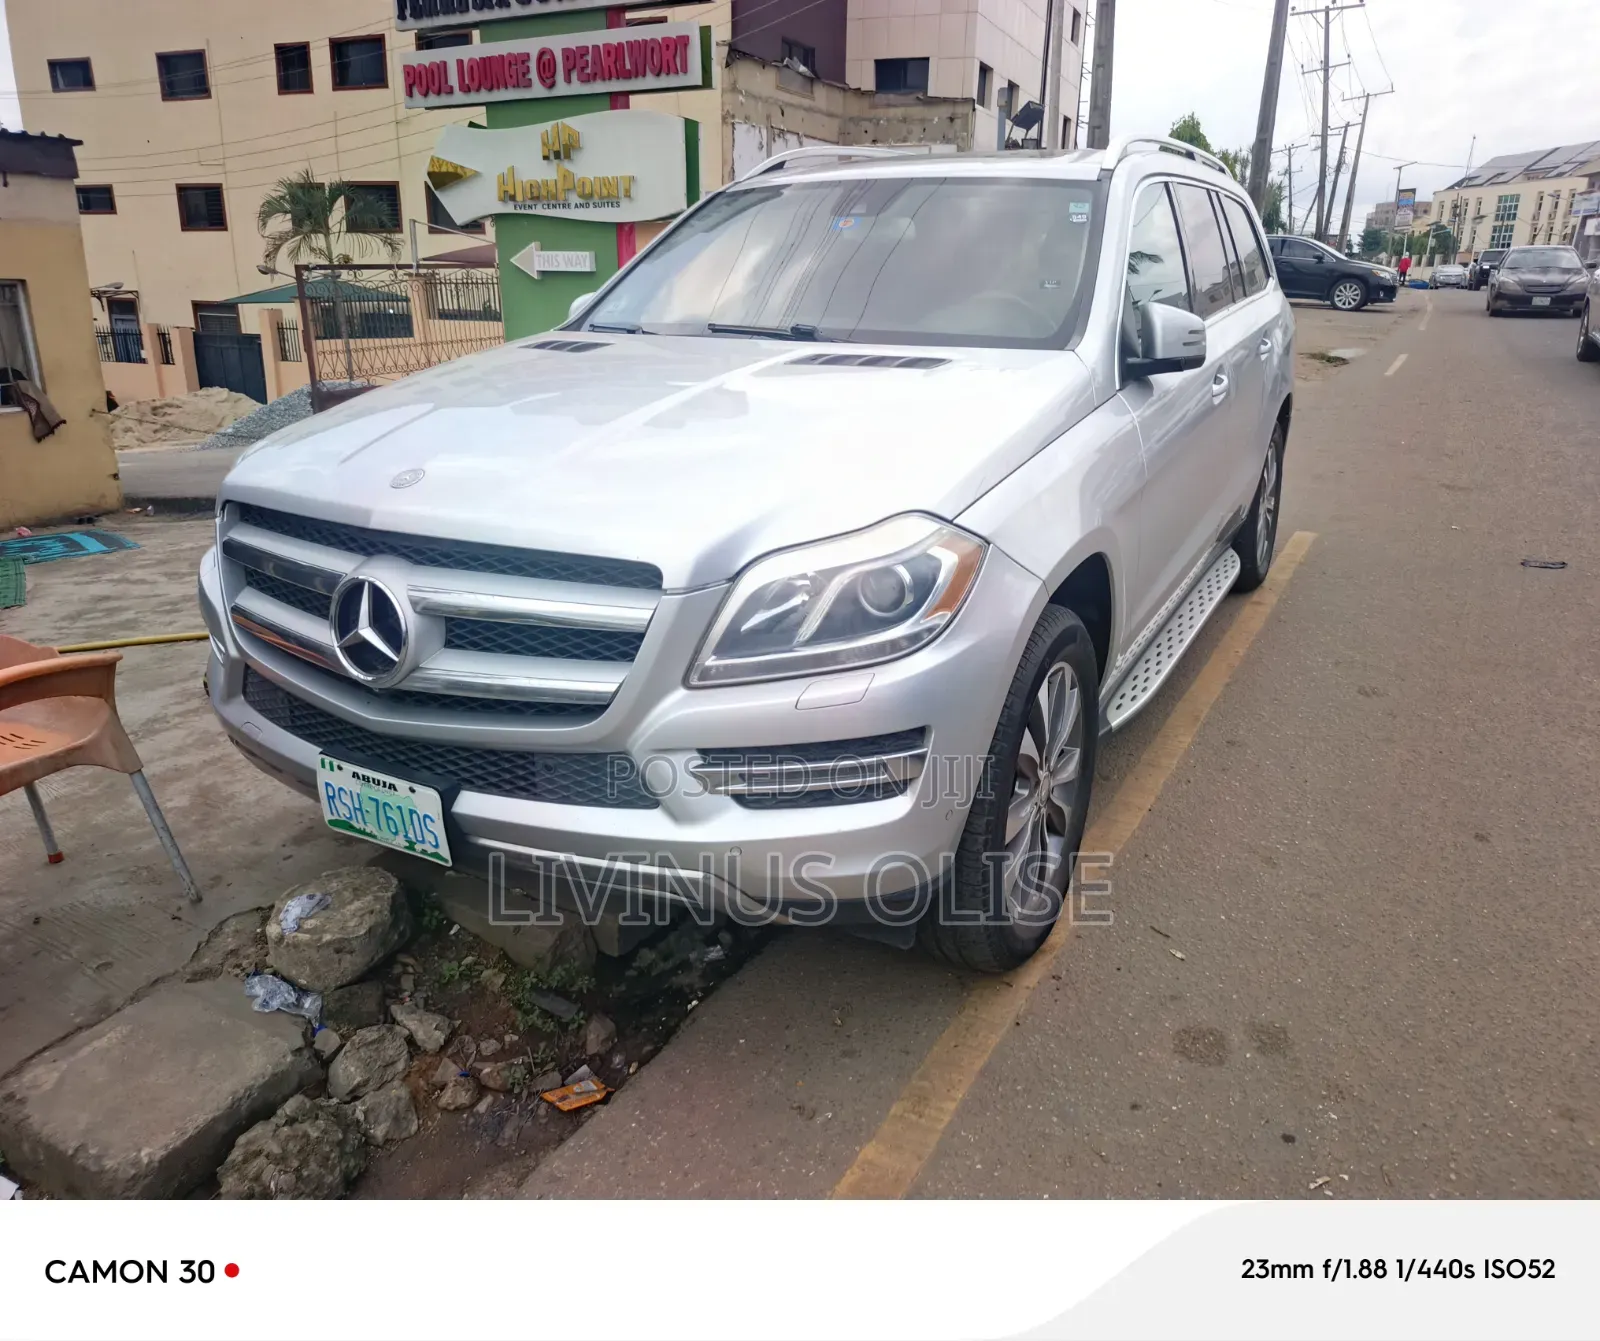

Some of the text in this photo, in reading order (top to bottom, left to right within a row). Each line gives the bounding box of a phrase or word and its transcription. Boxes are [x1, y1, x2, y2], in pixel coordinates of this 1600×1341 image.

[403, 35, 690, 97] POOL LOUNGE @ PEARLWORT
[513, 203, 537, 211] EVENT
[542, 202, 572, 210] CENTRE
[592, 201, 621, 209] SUITES
[535, 253, 588, 269] THIS WAY
[351, 771, 399, 792] ABUJA
